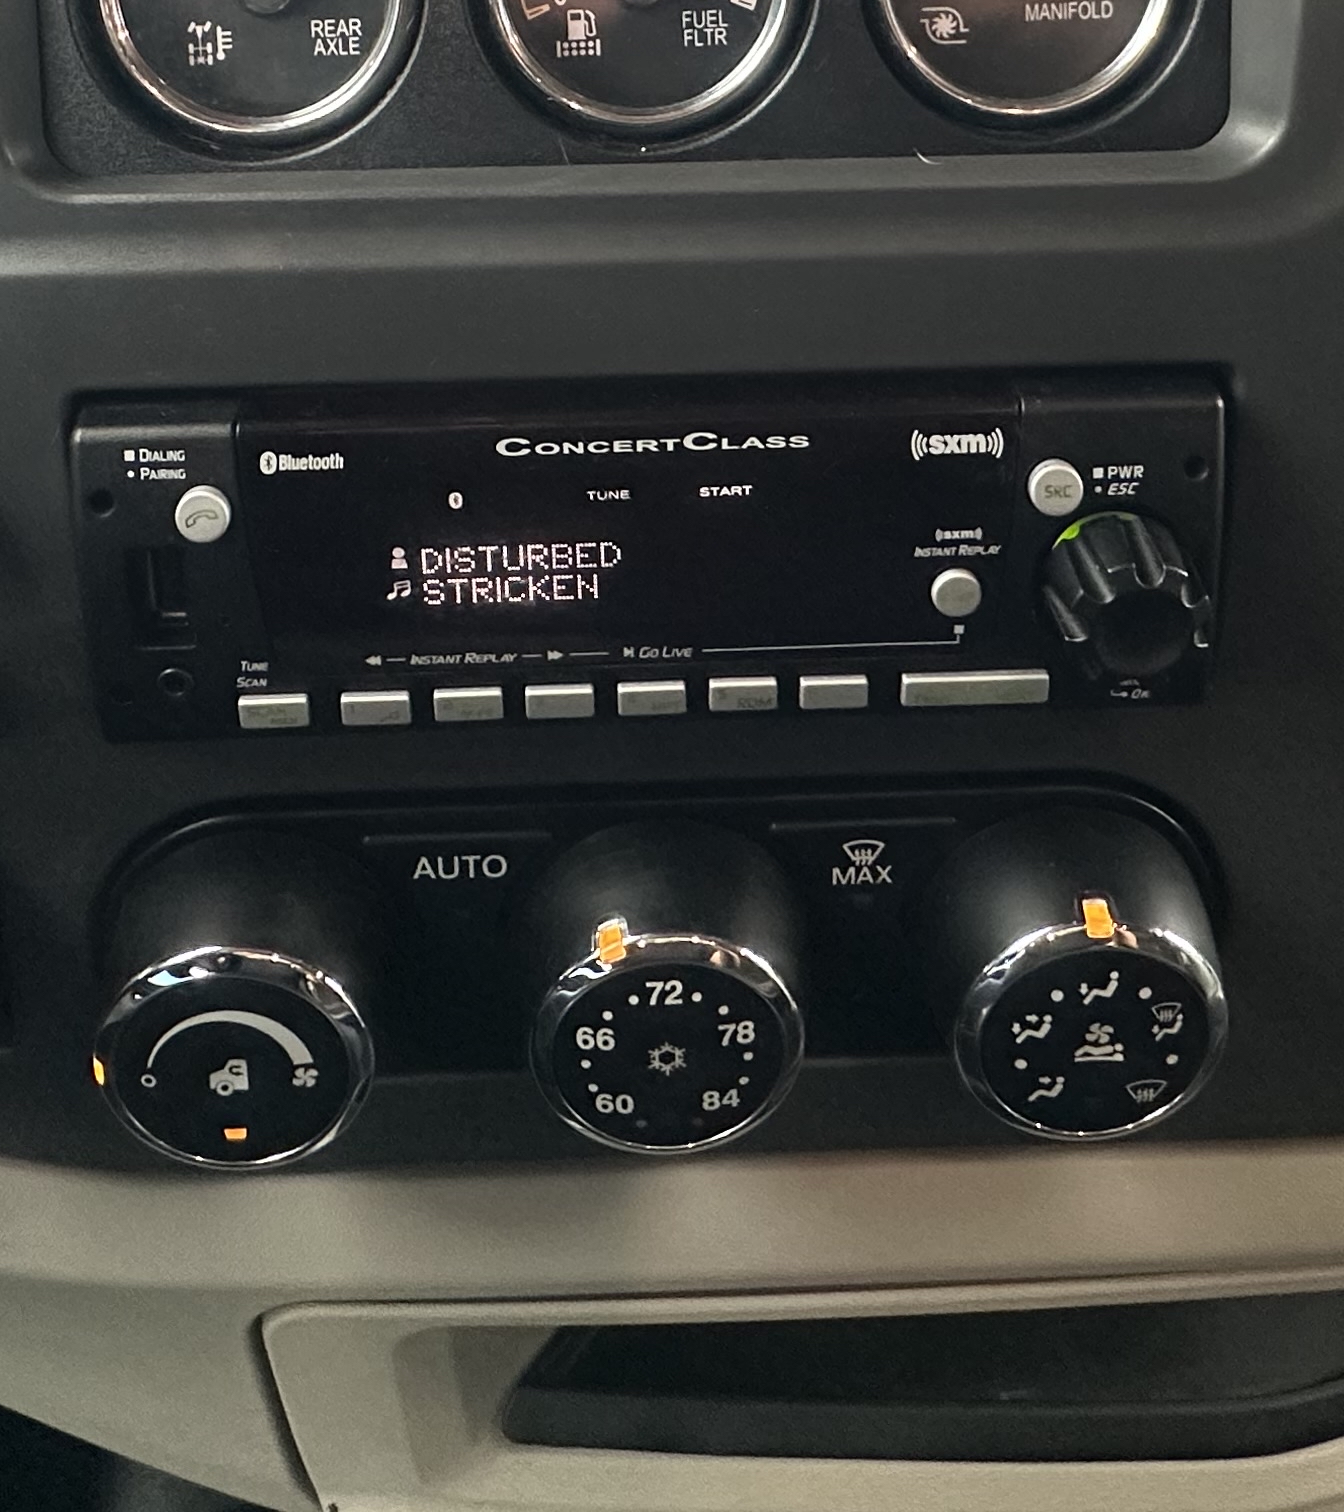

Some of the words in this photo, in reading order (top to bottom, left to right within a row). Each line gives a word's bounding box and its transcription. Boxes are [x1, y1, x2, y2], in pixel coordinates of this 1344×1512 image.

[681, 9, 729, 29] FUEL
[1024, 0, 1114, 23] MANIFOLD
[310, 17, 362, 38] REAR
[683, 28, 728, 47] FLTR
[313, 36, 360, 56] AXLE
[278, 452, 345, 472] Bluetooth
[1107, 464, 1144, 480] PWR
[586, 488, 632, 502] TUNE
[698, 484, 754, 499] START
[1107, 482, 1140, 496] ESC
[420, 541, 623, 575] DISTURBED
[421, 574, 600, 606] STRICKEN
[413, 854, 509, 881] AUTO
[831, 864, 893, 886] MAX
[644, 980, 683, 1007] 72
[575, 1026, 616, 1051] 66
[717, 1020, 756, 1047] 78
[594, 1093, 635, 1115] 60
[701, 1089, 740, 1112] 84
